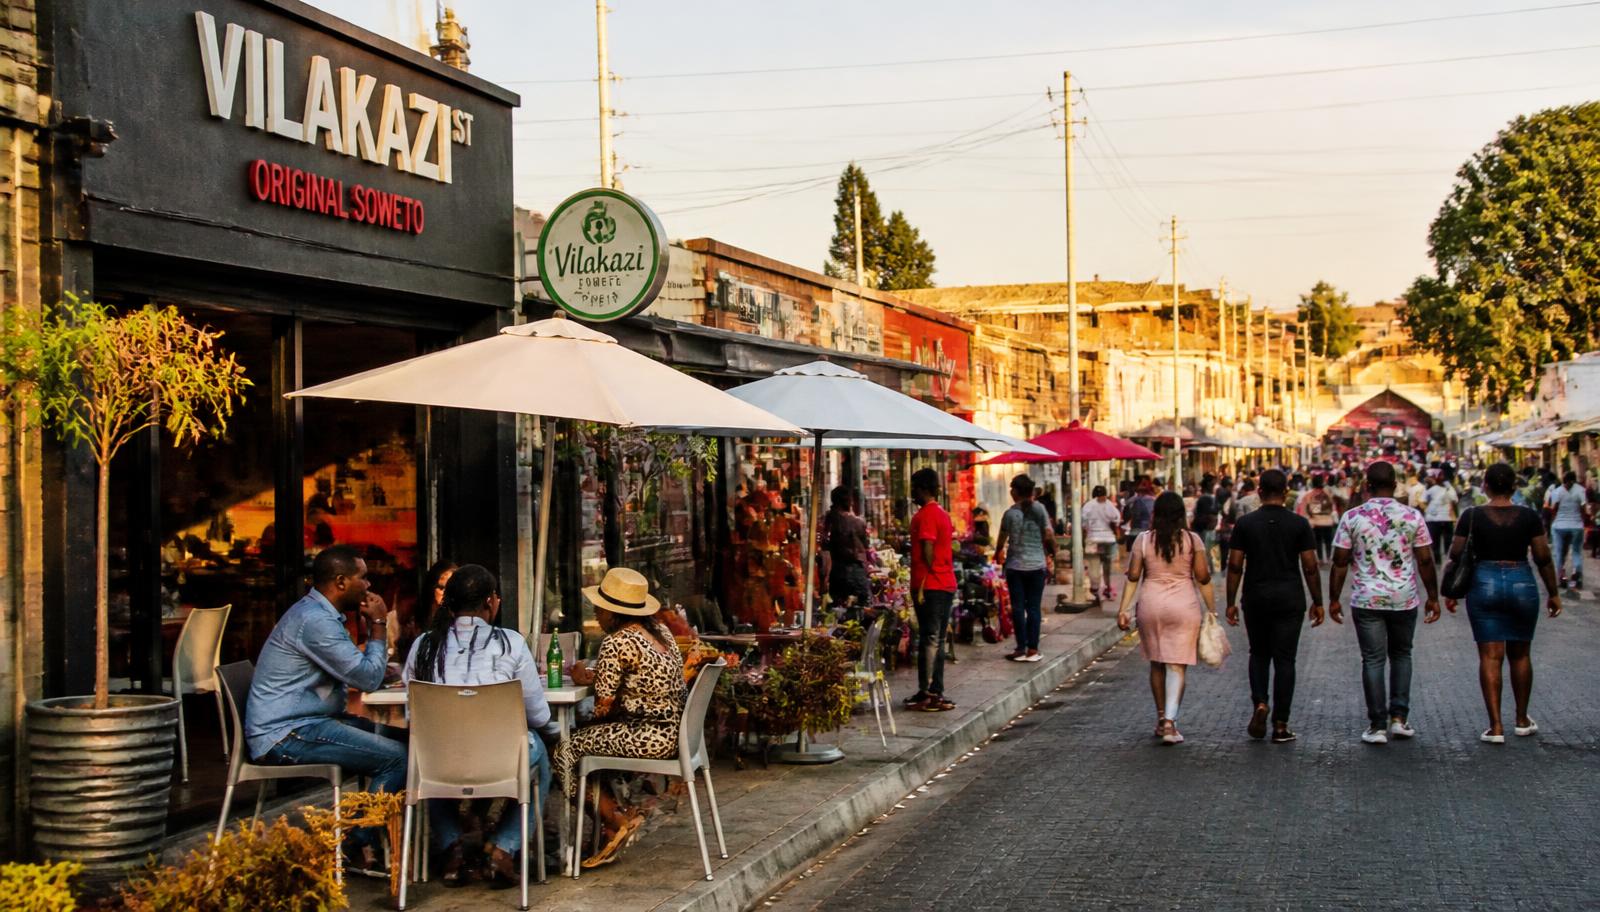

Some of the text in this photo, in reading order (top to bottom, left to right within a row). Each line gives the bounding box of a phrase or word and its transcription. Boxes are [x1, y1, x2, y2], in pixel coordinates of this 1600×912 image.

[195, 10, 474, 184] VILAKAZI ST
[250, 159, 424, 234] ORIGINAL SOWETO
[554, 242, 645, 277] Vilakazi
